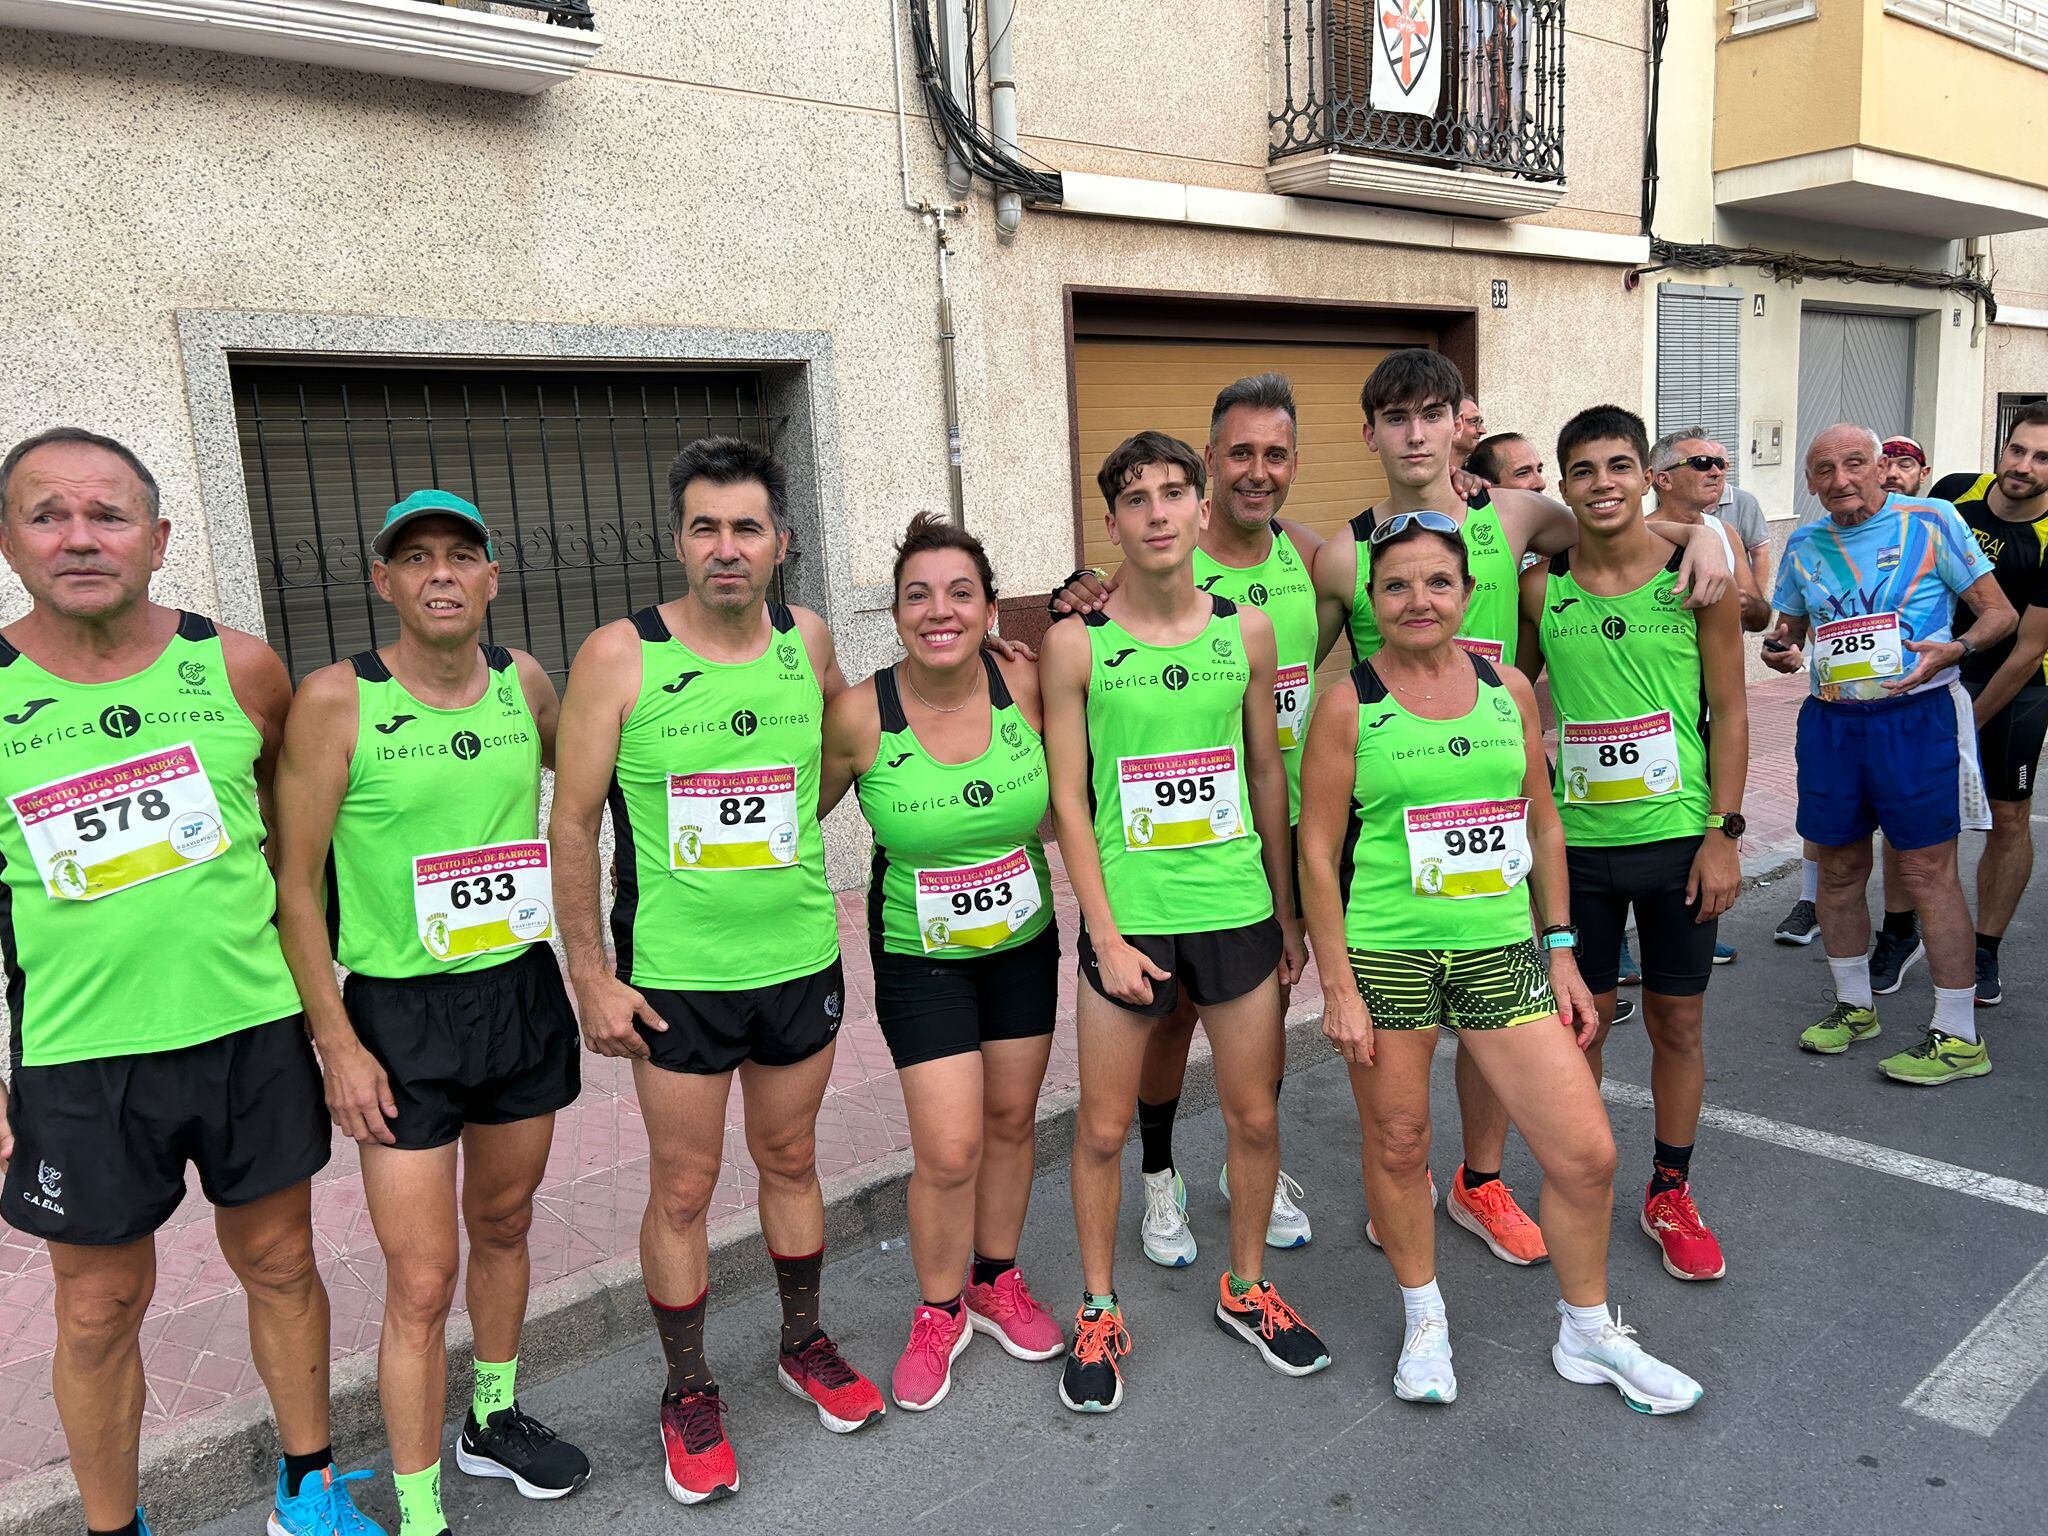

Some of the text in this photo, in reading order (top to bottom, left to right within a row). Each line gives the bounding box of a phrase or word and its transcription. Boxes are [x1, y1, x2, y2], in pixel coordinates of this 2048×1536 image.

[1493, 281, 1507, 306] 33
[1754, 297, 1764, 315] A
[1269, 583, 1307, 597] correas
[1826, 576, 1889, 620] XIV
[1548, 624, 1687, 639] ibérica correas
[1831, 634, 1876, 656] 285
[178, 688, 212, 697] C.A. ELDA
[1100, 671, 1247, 692] ibérica correas
[1274, 689, 1296, 714] 46
[4, 709, 225, 758] ibérica correas
[661, 713, 809, 738] ibérica correas
[1620, 725, 1631, 733] DE
[1633, 718, 1666, 731] BARRIOS
[377, 732, 529, 761] ibérica correa
[1598, 742, 1640, 768] 86
[1165, 760, 1186, 769] LIGA
[1188, 758, 1199, 766] DE
[18, 755, 187, 814] CIRCUITO LIGA DE BARRIOS
[722, 777, 745, 786] LIGA
[747, 776, 759, 784] DE
[996, 764, 1043, 794] correas
[2018, 764, 2027, 790] Joma
[1154, 776, 1216, 807] 995
[73, 789, 171, 843] 578
[719, 796, 766, 826] 82
[1456, 808, 1478, 818] LIGA
[1479, 807, 1490, 815] DE
[1444, 825, 1506, 856] 982
[418, 849, 541, 874] CIRCUITO LIGA DE BARRIOS
[963, 872, 984, 881] LIGA
[985, 868, 995, 877] DE
[450, 872, 516, 909] 633
[952, 882, 1013, 916] 963
[23, 1191, 65, 1216] C.A. ELDA
